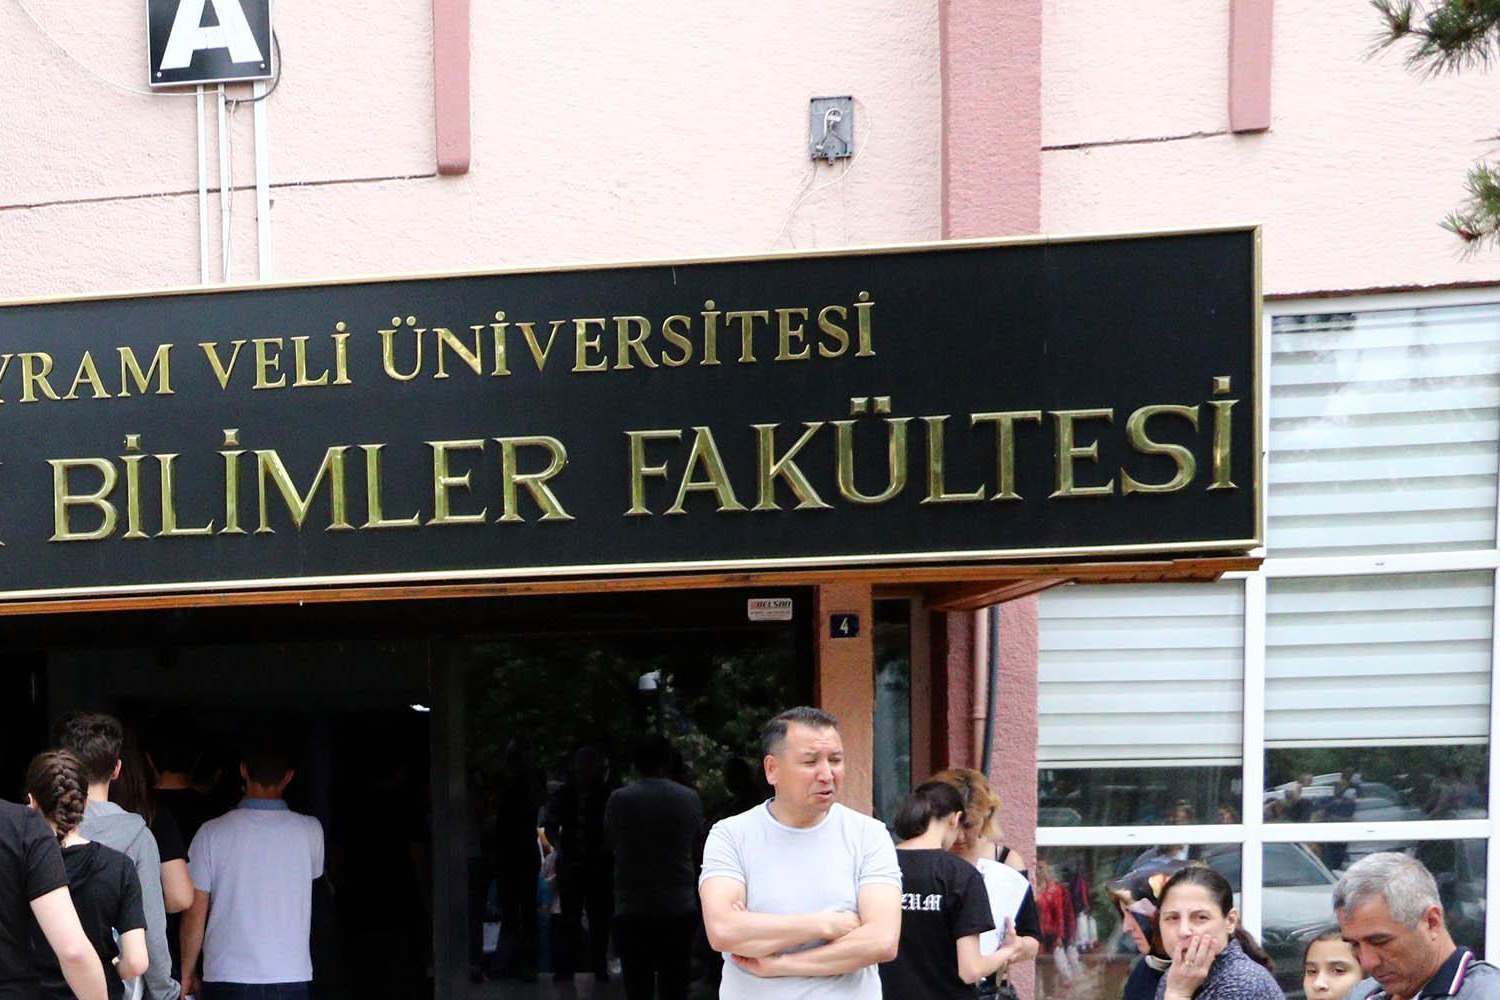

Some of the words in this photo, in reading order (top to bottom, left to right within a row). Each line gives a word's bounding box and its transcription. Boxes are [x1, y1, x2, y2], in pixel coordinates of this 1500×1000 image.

[160, 0, 264, 69] A
[197, 320, 353, 390] VELİ
[377, 290, 876, 383] ÜNİVERSİTESİ
[46, 427, 576, 541] BİLİMLER
[623, 375, 1240, 515] FAKÜLTESİ
[839, 616, 849, 635] 4
